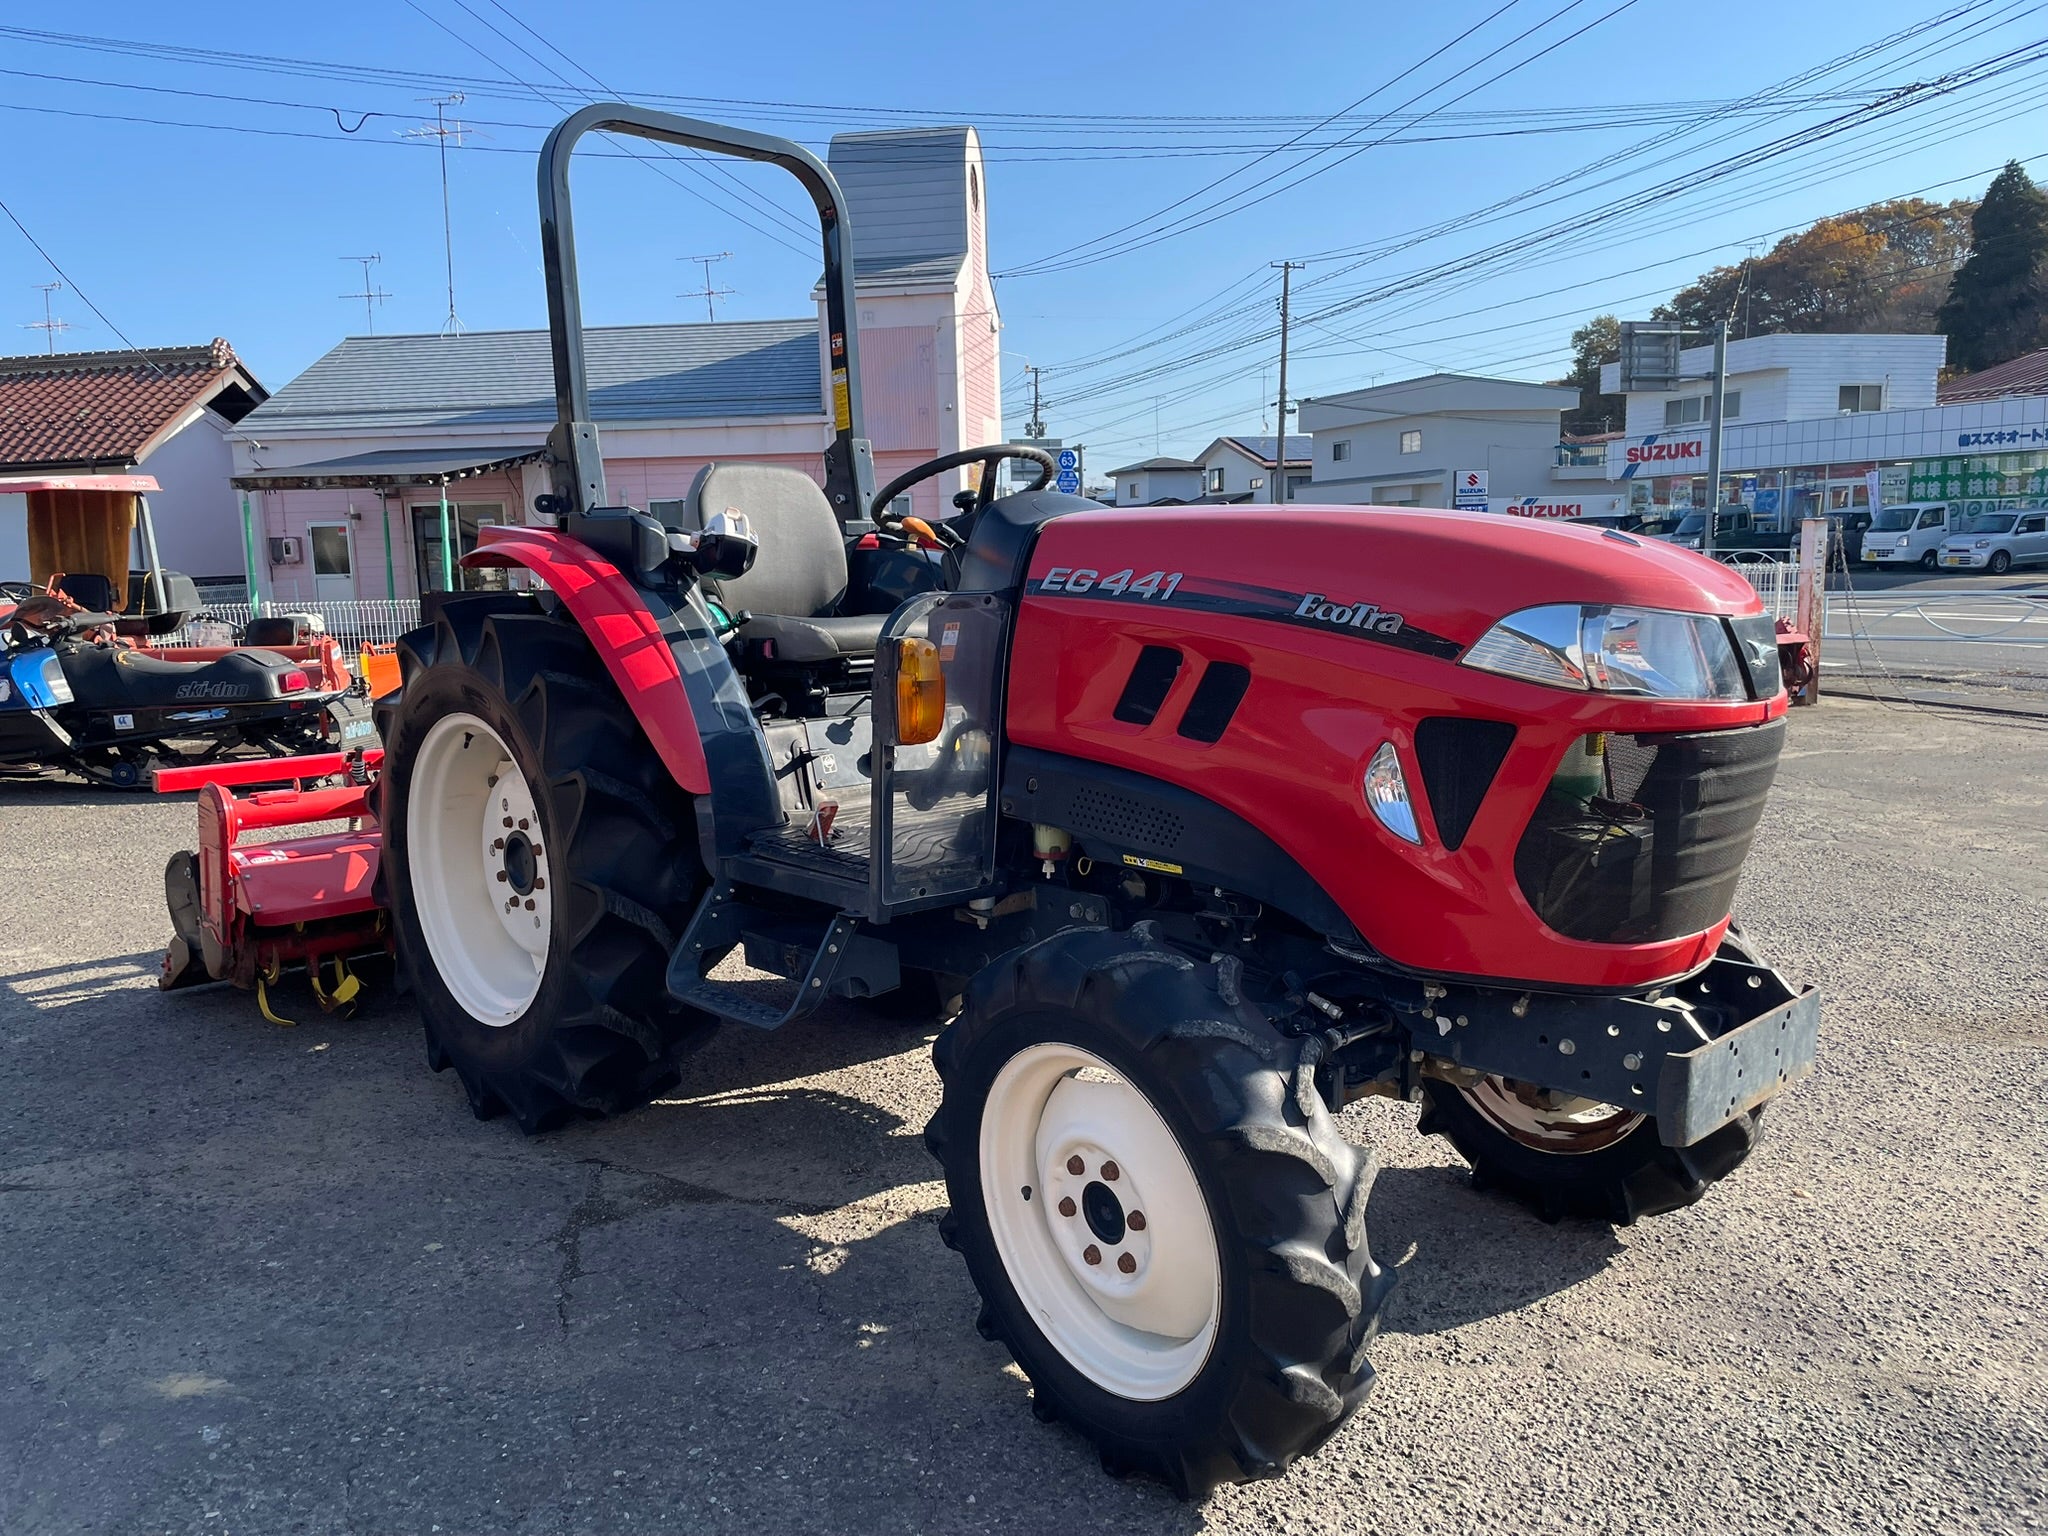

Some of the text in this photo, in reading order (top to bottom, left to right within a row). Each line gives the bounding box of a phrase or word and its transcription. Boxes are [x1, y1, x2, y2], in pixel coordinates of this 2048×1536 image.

[1626, 441, 1702, 463] SUZUKI
[1061, 456, 1073, 466] 63
[1506, 504, 1582, 519] SUZUKI
[1294, 592, 1406, 636] EcoTra
[177, 681, 248, 698] ski-doo
